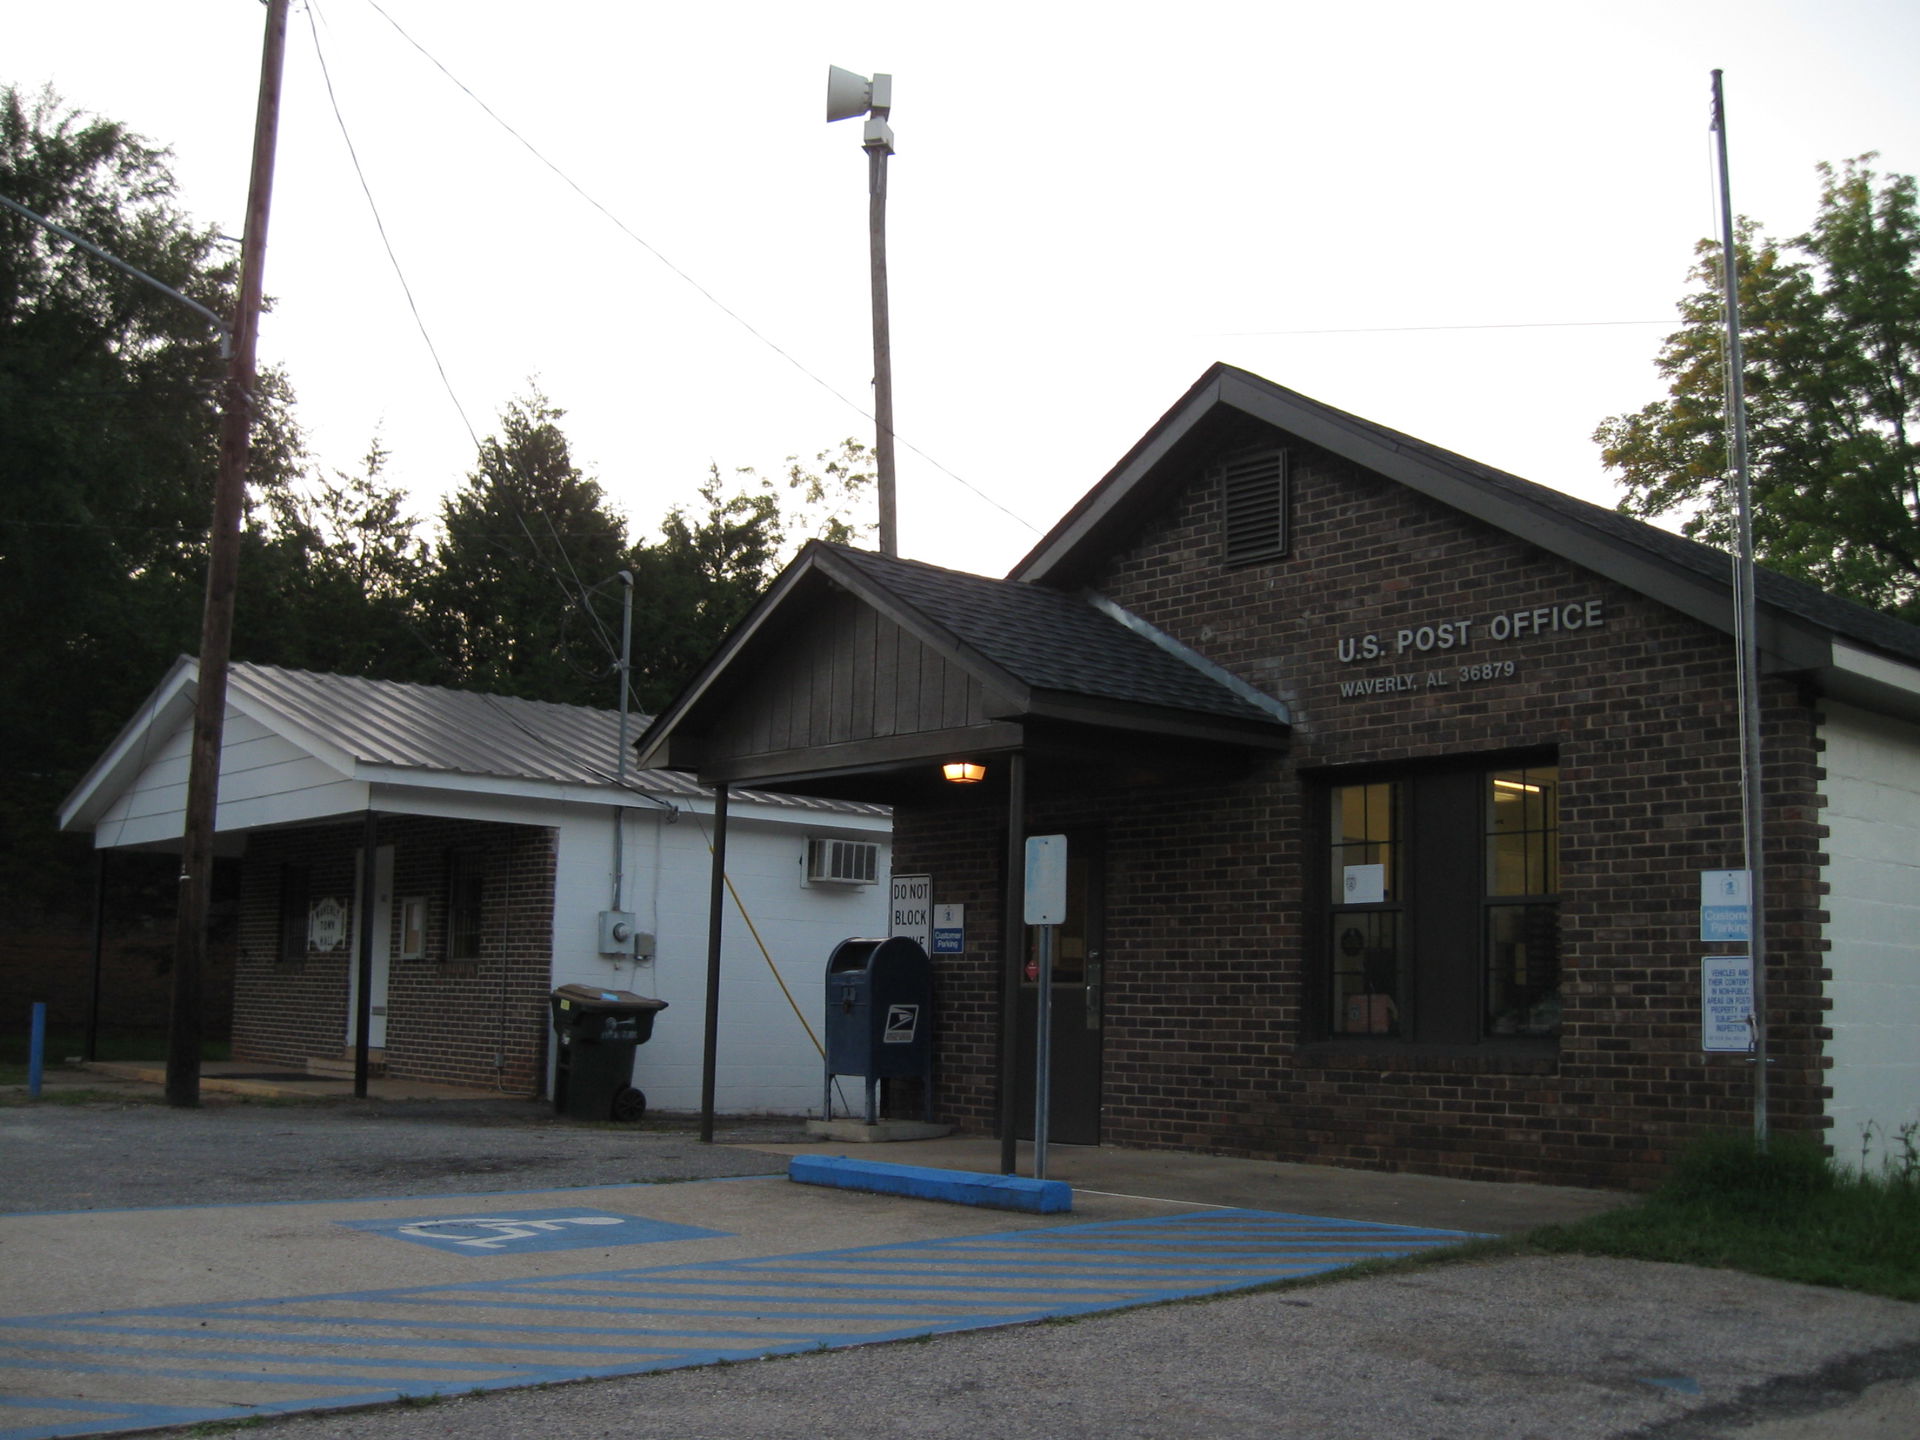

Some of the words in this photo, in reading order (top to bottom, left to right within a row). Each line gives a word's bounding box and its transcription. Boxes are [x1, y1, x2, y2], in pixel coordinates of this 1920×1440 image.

[1338, 634, 1385, 663] U.S.
[1397, 620, 1472, 654] POST
[1490, 600, 1604, 641] OFFICE
[1340, 674, 1418, 698] WAVERLY,
[1426, 670, 1448, 688] AL
[1459, 661, 1515, 682] 36879
[894, 884, 907, 900] DO
[910, 883, 929, 899] NOT
[895, 910, 927, 925] BLOCK
[935, 931, 961, 939] Customer
[937, 940, 958, 949] Parking
[1712, 968, 1736, 977] VEHICLES
[1738, 968, 1749, 976] AND
[1708, 978, 1723, 986] THEIR
[1707, 996, 1724, 1004] AREAS
[1711, 1005, 1738, 1014] PROPERTY
[1716, 1024, 1747, 1032] INSPECTION
